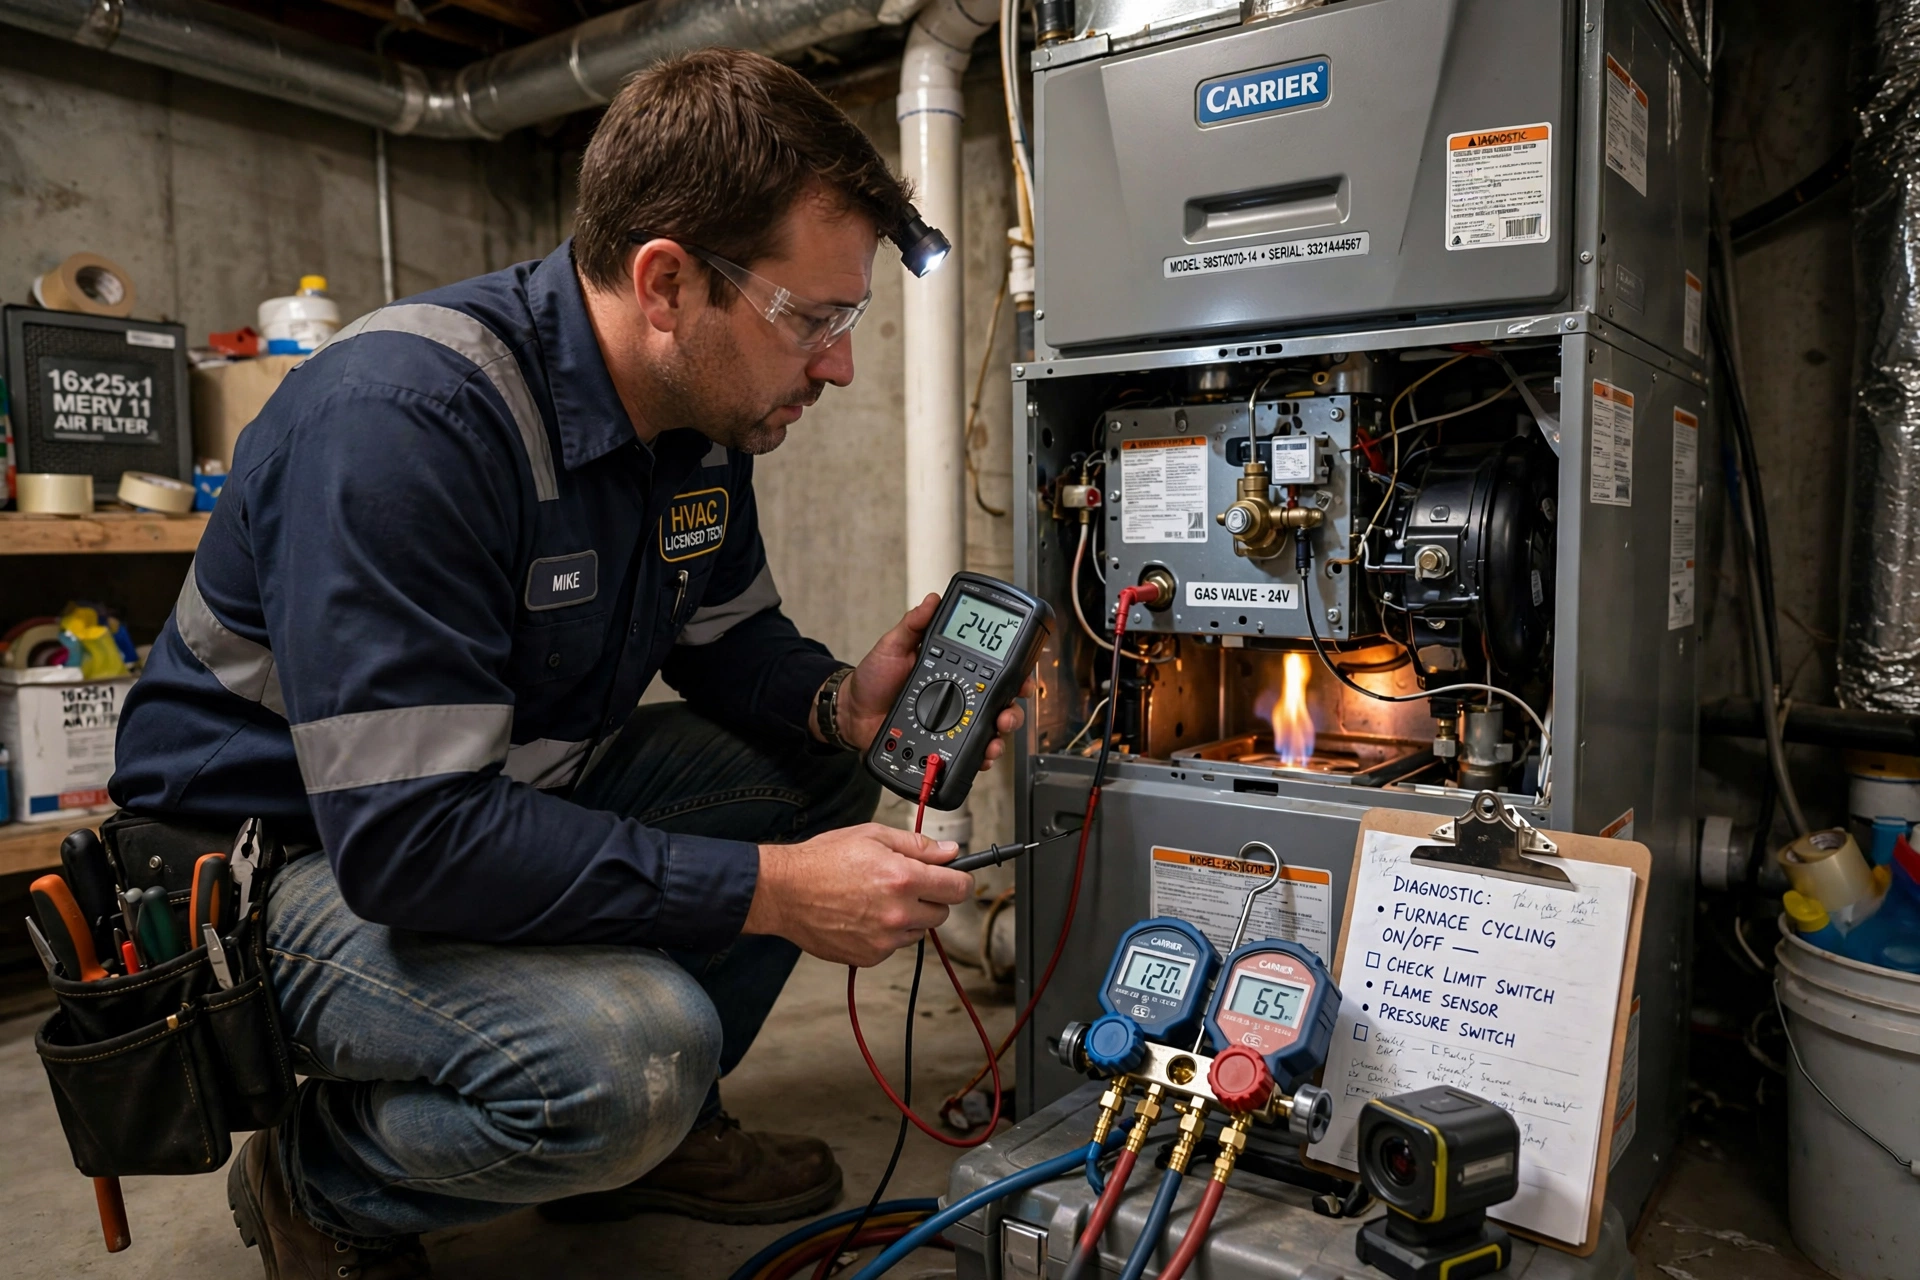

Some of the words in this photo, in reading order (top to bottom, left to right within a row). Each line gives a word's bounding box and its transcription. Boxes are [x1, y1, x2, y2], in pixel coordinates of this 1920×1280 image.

[1206, 71, 1320, 114] CARRIER
[1170, 257, 1201, 274] MODEL:
[1268, 244, 1304, 261] SERIAL:
[1306, 237, 1362, 255] 3321A44567
[48, 368, 152, 398] 16x25x1
[53, 392, 122, 416] MERV
[128, 398, 151, 418] 11
[54, 414, 88, 431] AIR
[92, 415, 149, 434] FILTER
[671, 499, 718, 533] HVAC
[665, 529, 705, 551] LICENSED
[552, 571, 580, 592] MIKE
[1194, 587, 1218, 601] GAS
[1221, 588, 1257, 602] VALVE
[1268, 589, 1290, 603] 24V
[957, 611, 1007, 651] 24.6
[1393, 876, 1492, 905] DIAGNOSTIC:
[1382, 926, 1445, 951] ON/OFF
[1393, 902, 1470, 932] FURNACE
[1481, 919, 1557, 949] CYCLING
[1140, 962, 1181, 994] 120
[1386, 956, 1434, 979] CHECK
[1443, 966, 1487, 990] LIMIT
[1495, 979, 1555, 1005] SWITCH
[1253, 987, 1290, 1020] 65
[1383, 980, 1433, 1004] FLAME
[1441, 994, 1499, 1019] SENSOR
[1379, 1003, 1449, 1032] PRESSURE
[1459, 1022, 1516, 1049] SWITCH
